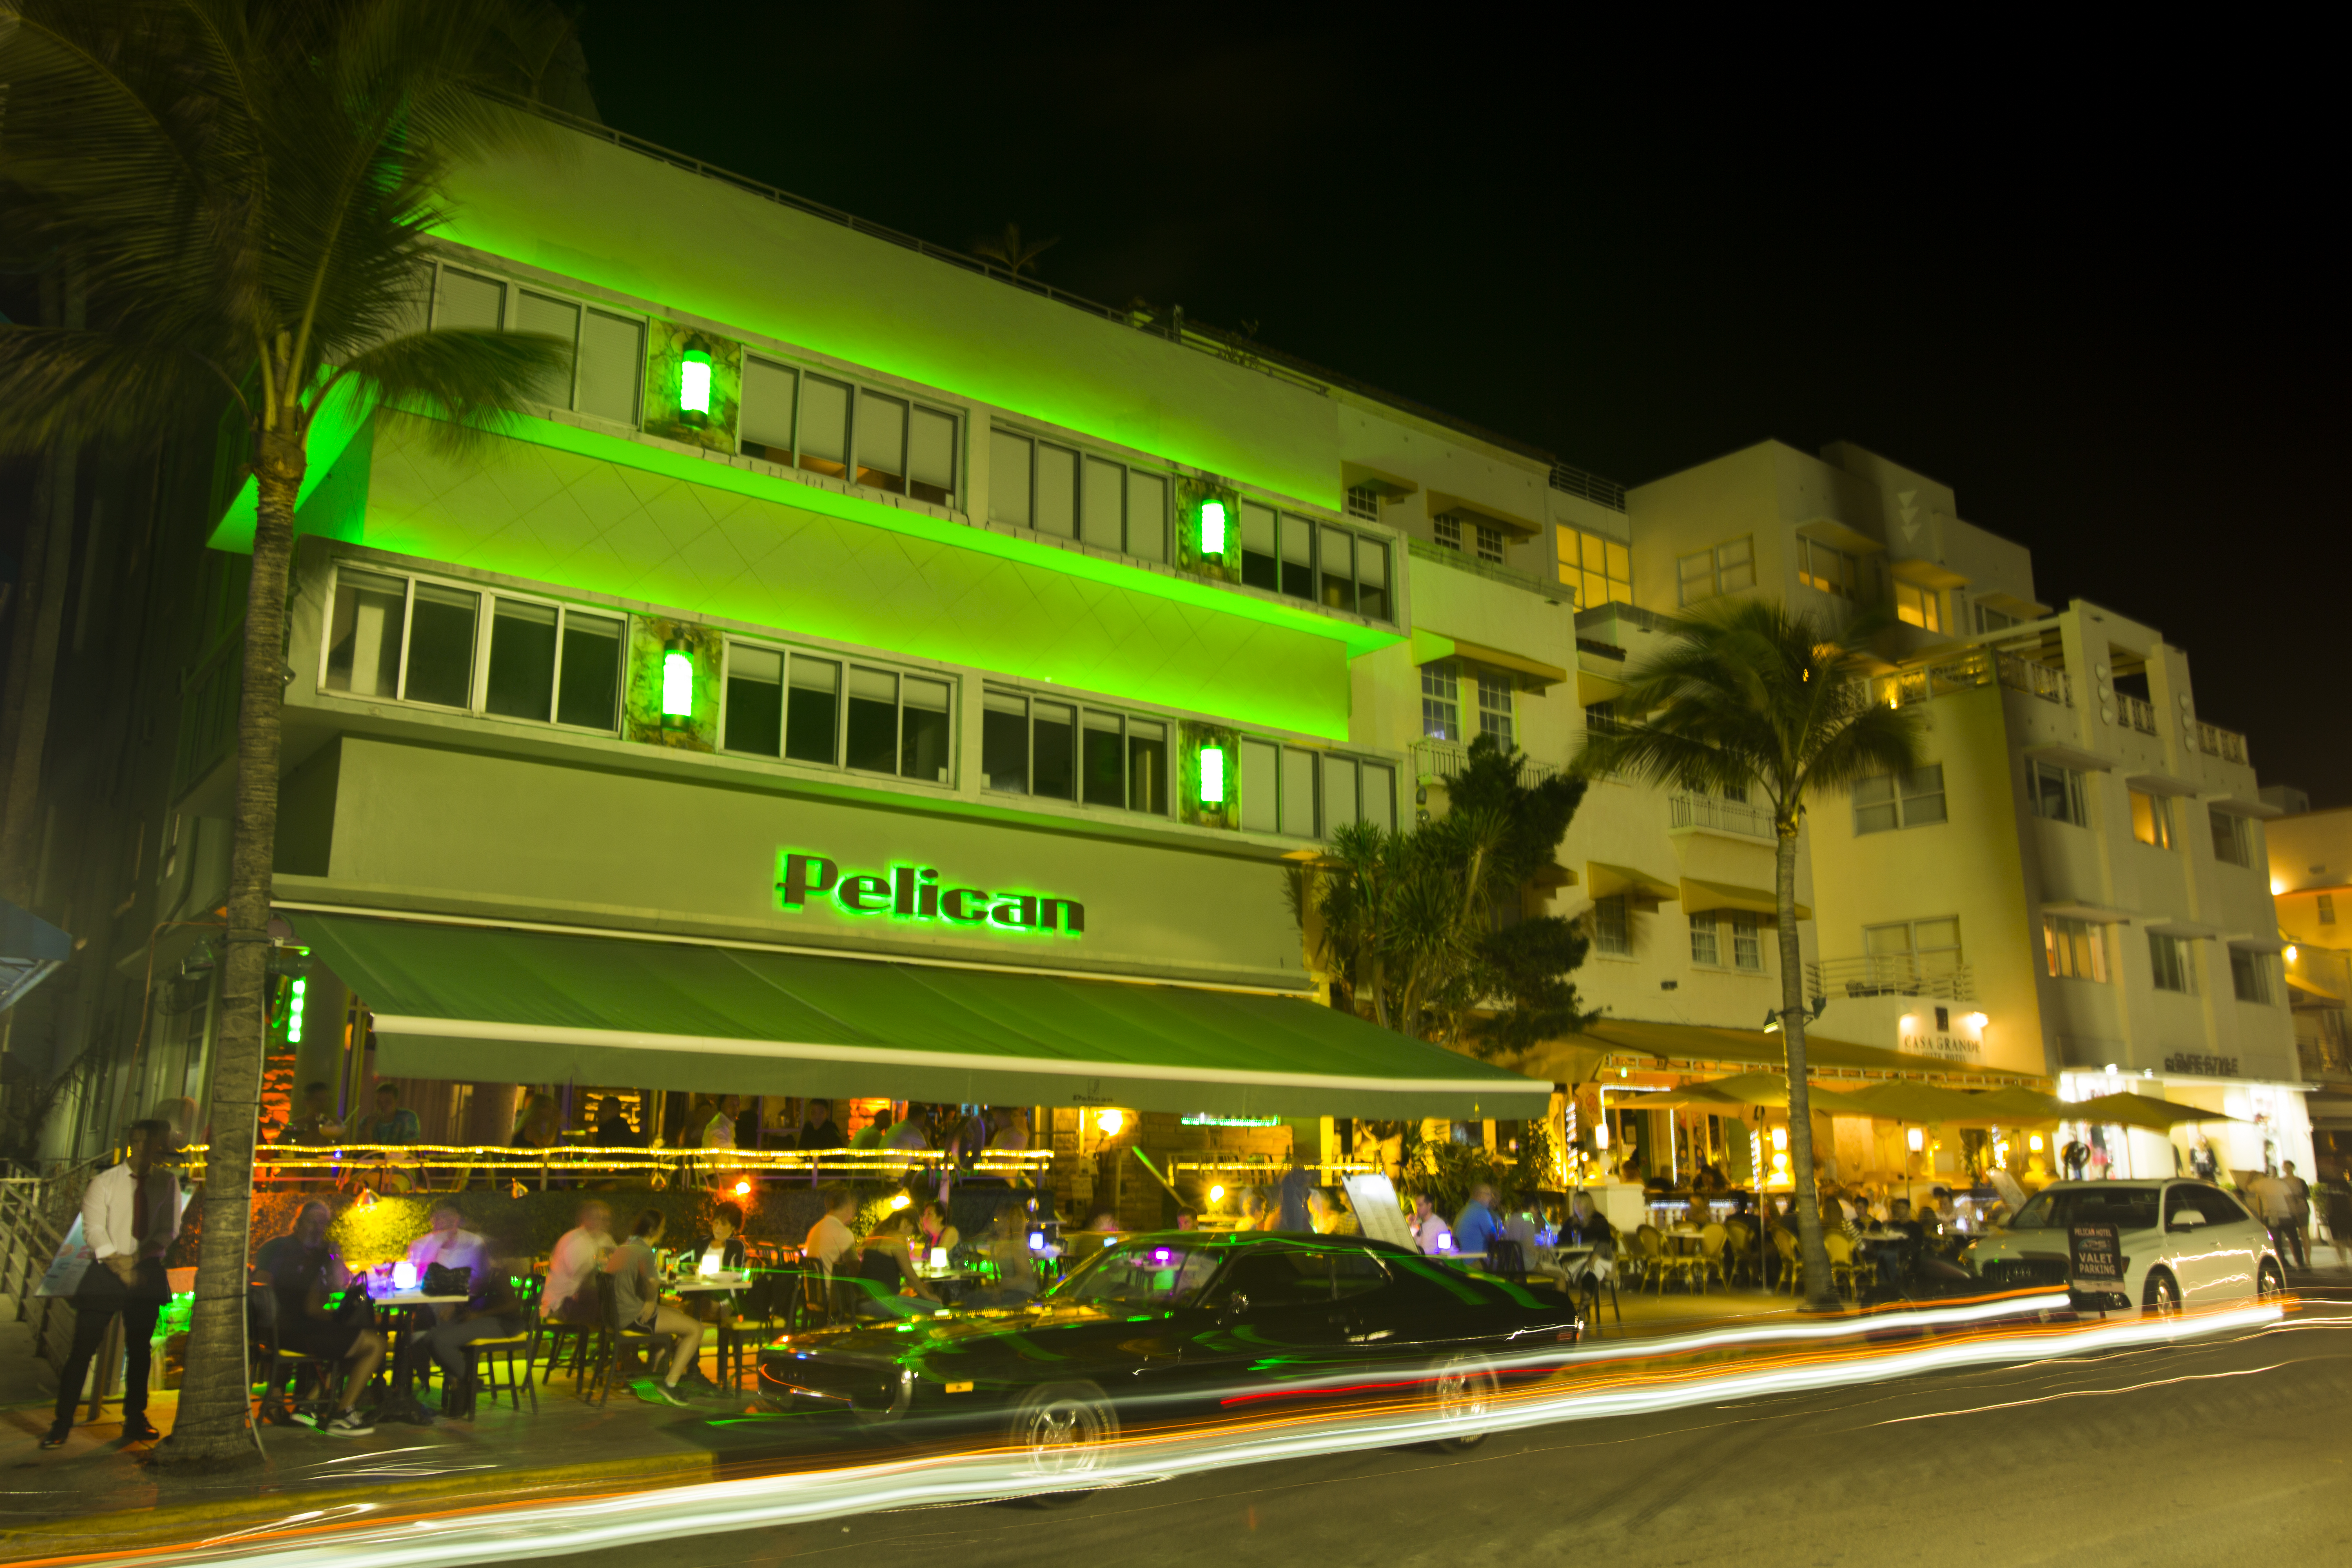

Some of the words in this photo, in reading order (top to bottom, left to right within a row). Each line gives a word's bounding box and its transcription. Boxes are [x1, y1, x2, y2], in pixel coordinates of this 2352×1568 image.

[775, 853, 1085, 933] Pelican
[1904, 1034, 1933, 1049] CASA
[1936, 1037, 1980, 1053] GRANDE
[2074, 1227, 2095, 1237] PELICAN
[2096, 1228, 2112, 1237] HOTEL
[2078, 1252, 2113, 1264] VALET
[2079, 1263, 2116, 1275] PARKING
